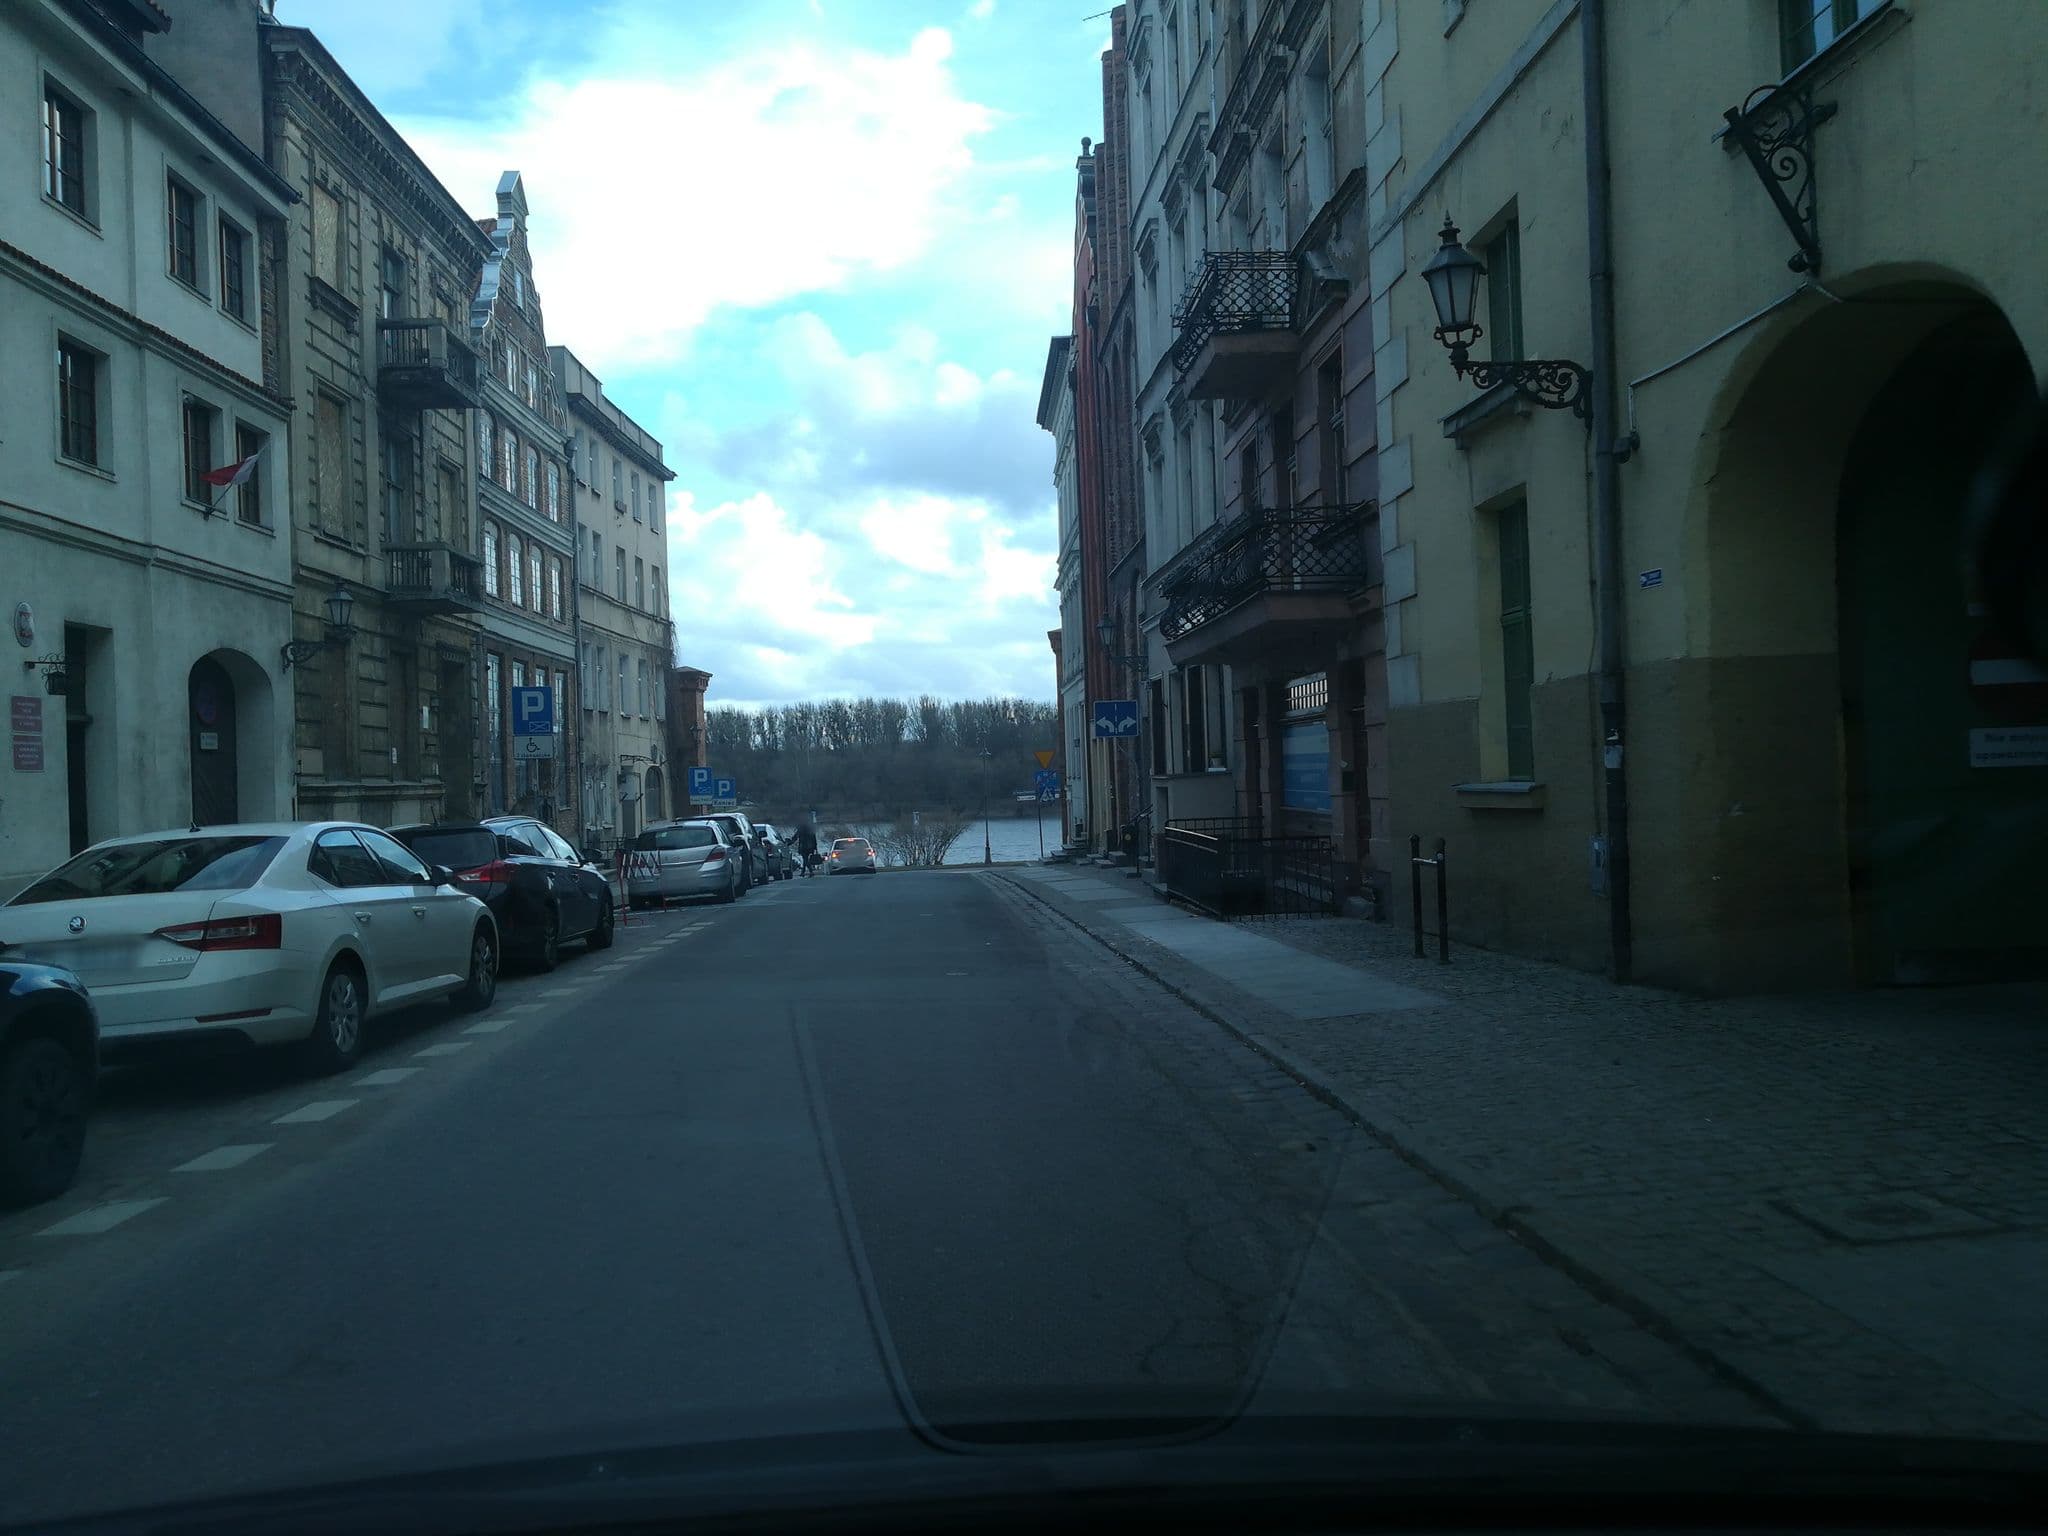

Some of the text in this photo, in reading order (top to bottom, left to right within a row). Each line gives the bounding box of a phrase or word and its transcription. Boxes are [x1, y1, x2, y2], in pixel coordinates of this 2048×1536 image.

[521, 691, 544, 720] P
[694, 769, 707, 787] P
[718, 780, 730, 797] P
